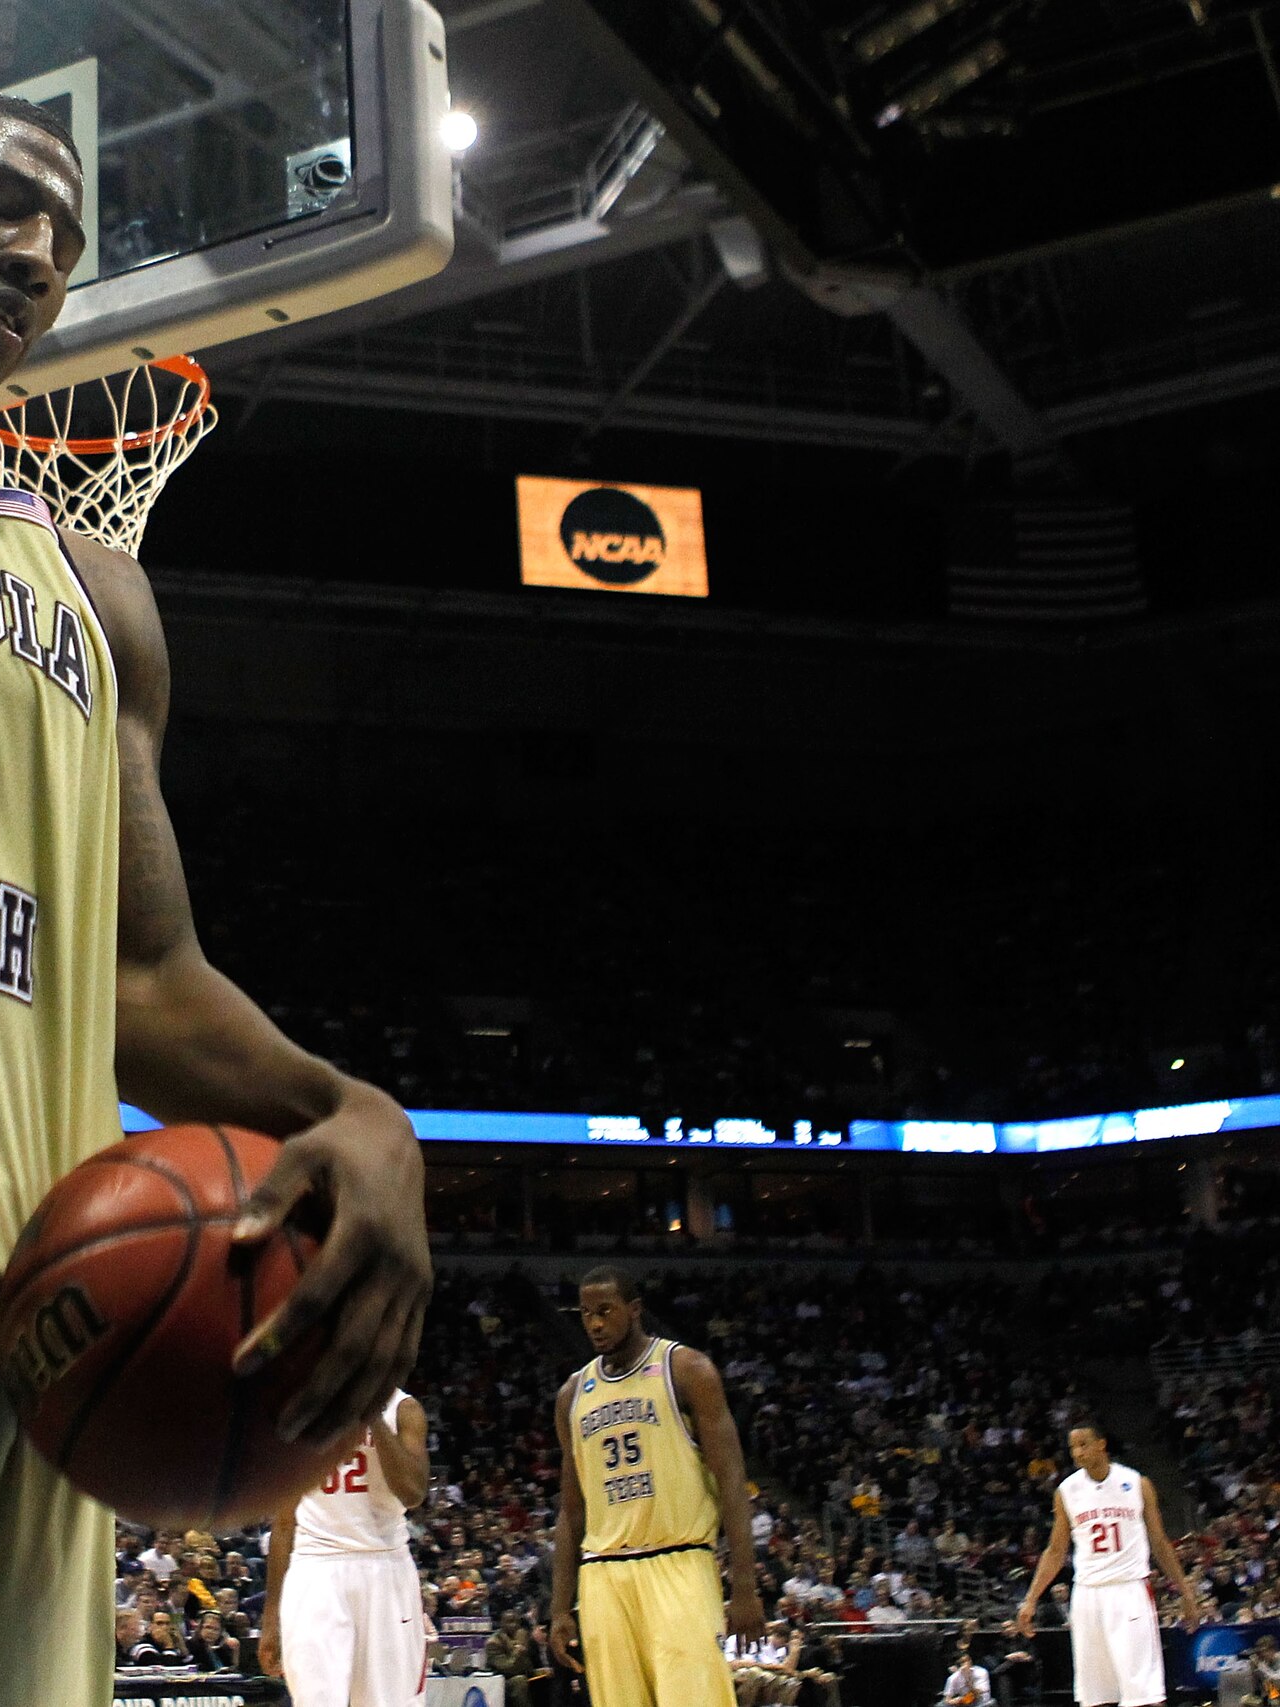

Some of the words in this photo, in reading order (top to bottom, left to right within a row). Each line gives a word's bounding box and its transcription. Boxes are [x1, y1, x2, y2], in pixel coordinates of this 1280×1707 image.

[571, 530, 665, 565] NCAA
[581, 1398, 660, 1438] GEORGIA
[602, 1432, 640, 1469] 35
[604, 1473, 654, 1505] TECH
[1090, 1522, 1122, 1553] 21
